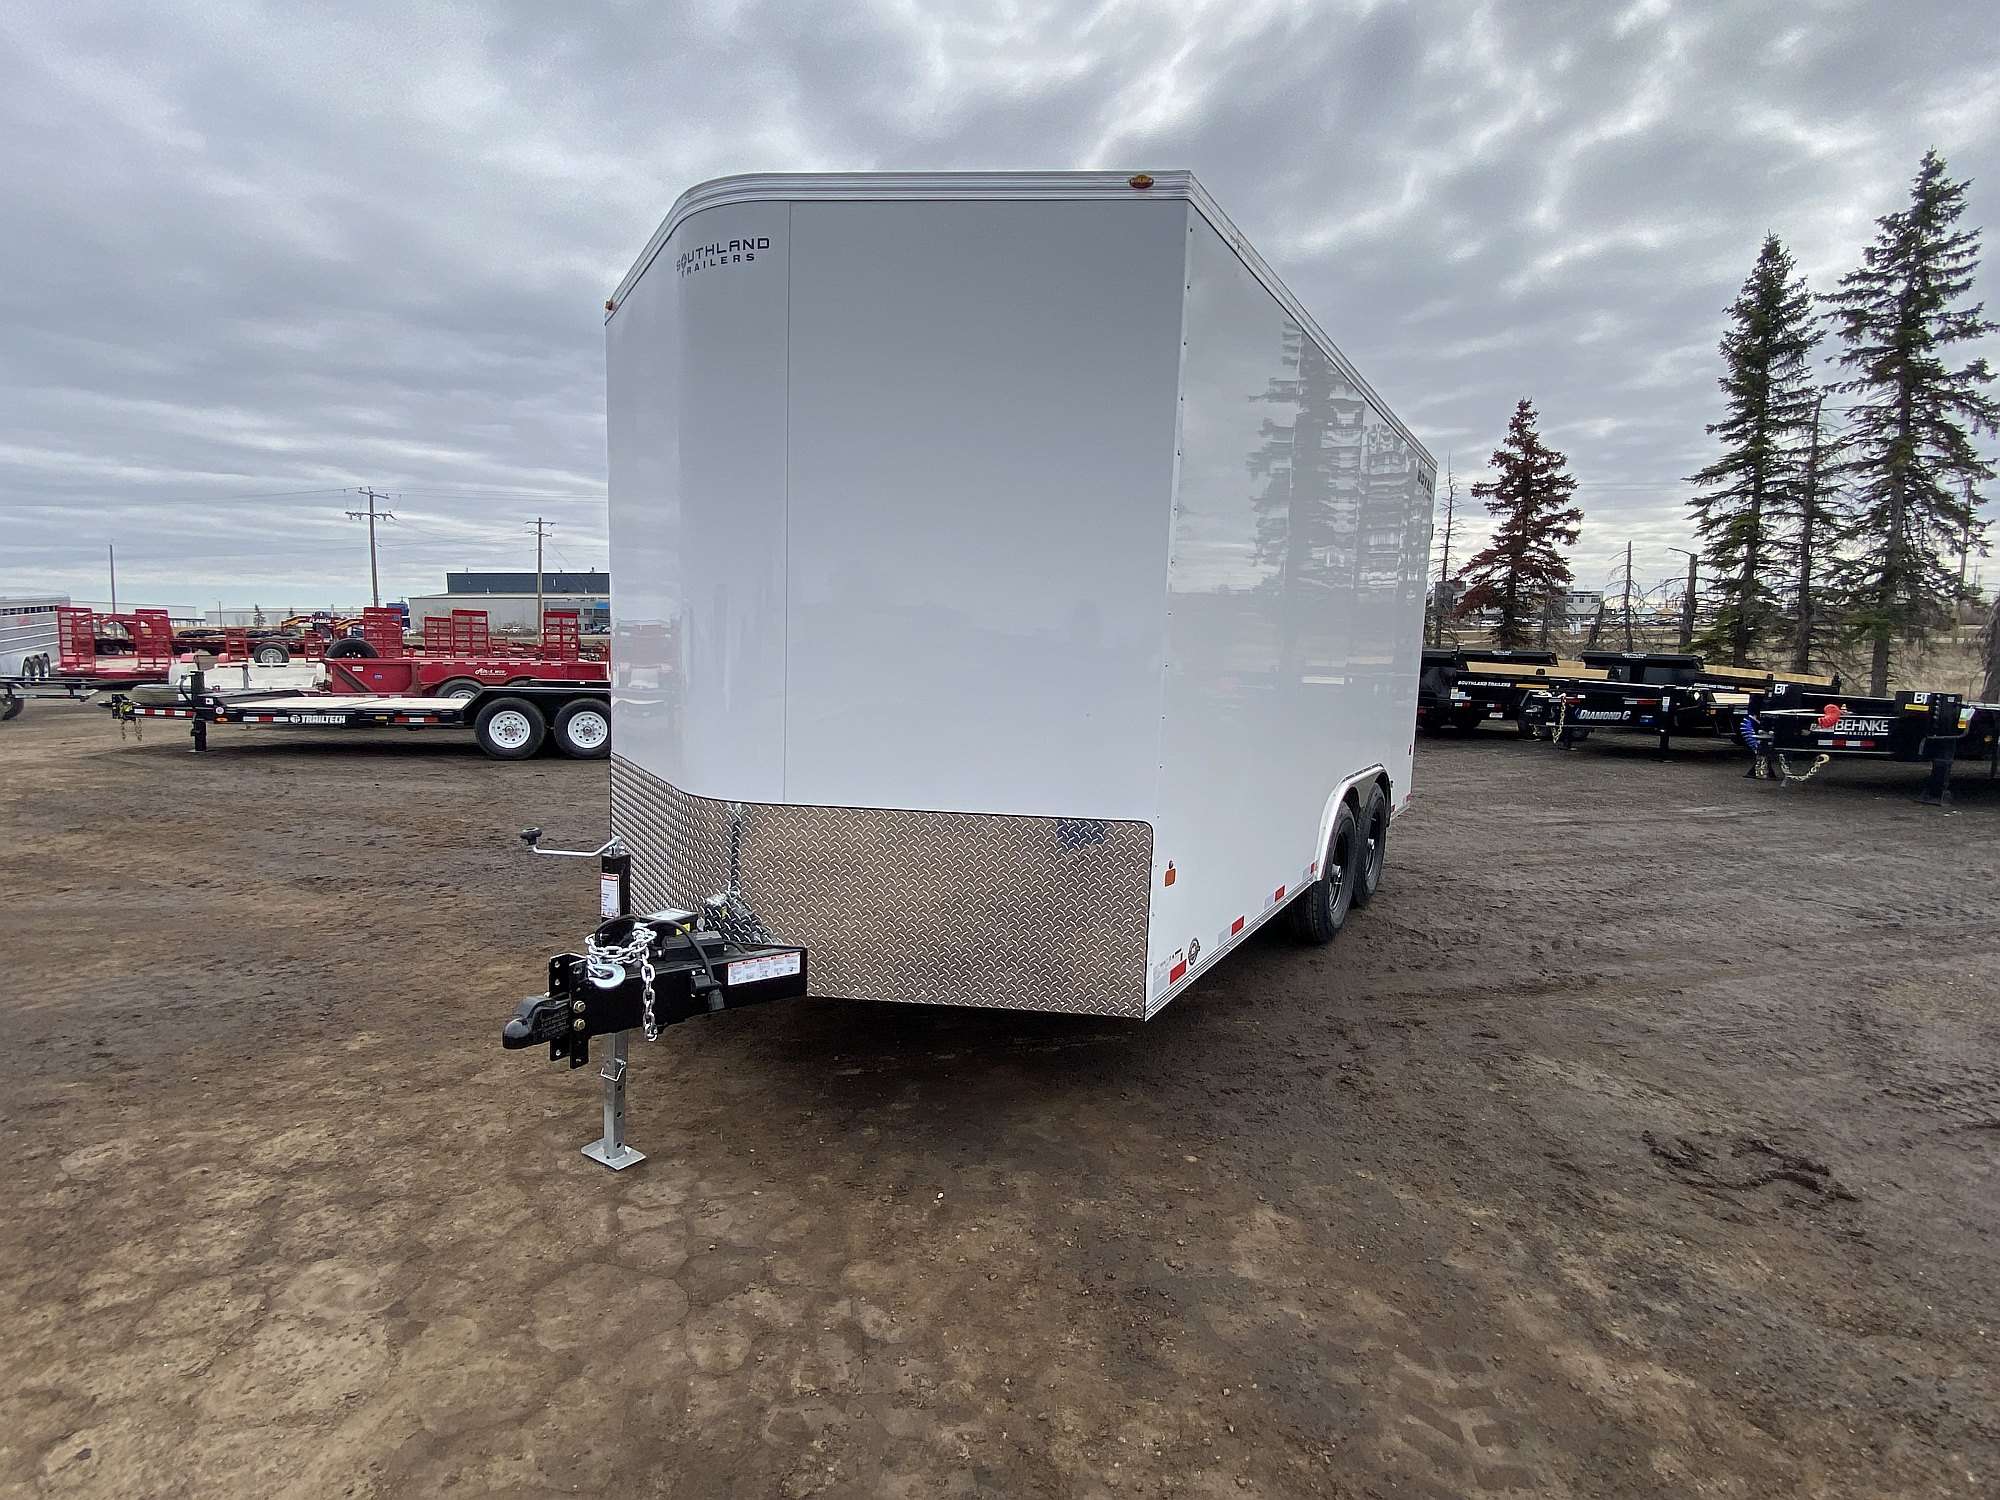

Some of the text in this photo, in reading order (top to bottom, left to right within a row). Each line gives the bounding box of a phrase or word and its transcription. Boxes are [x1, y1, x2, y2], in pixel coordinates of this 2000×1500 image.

[676, 237, 770, 272] SOUTHLAND
[681, 253, 755, 278] TRAILERS
[301, 715, 346, 724] TRAILTECH
[1579, 709, 1631, 720] DIAMOND C
[1835, 719, 1889, 732] BEHNKE
